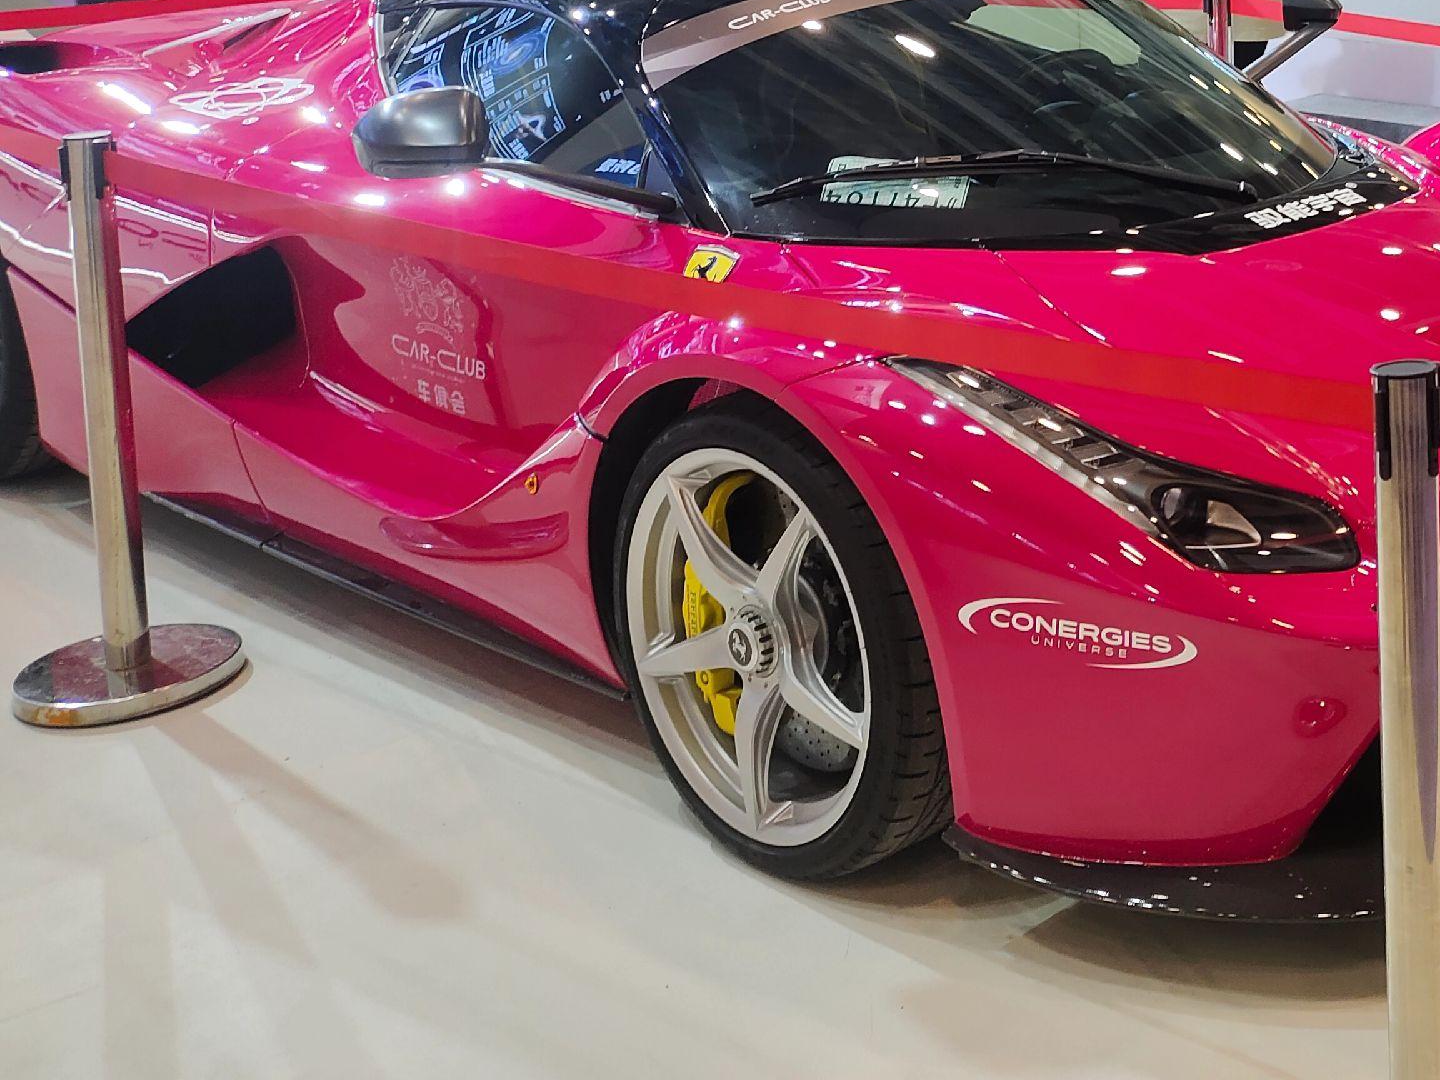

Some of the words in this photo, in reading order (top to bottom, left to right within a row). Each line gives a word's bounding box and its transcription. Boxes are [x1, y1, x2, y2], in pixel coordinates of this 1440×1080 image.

[390, 334, 486, 381] CAR-CLUB
[990, 609, 1172, 654] CONERGIES
[1031, 635, 1127, 659] UNIVERSE
